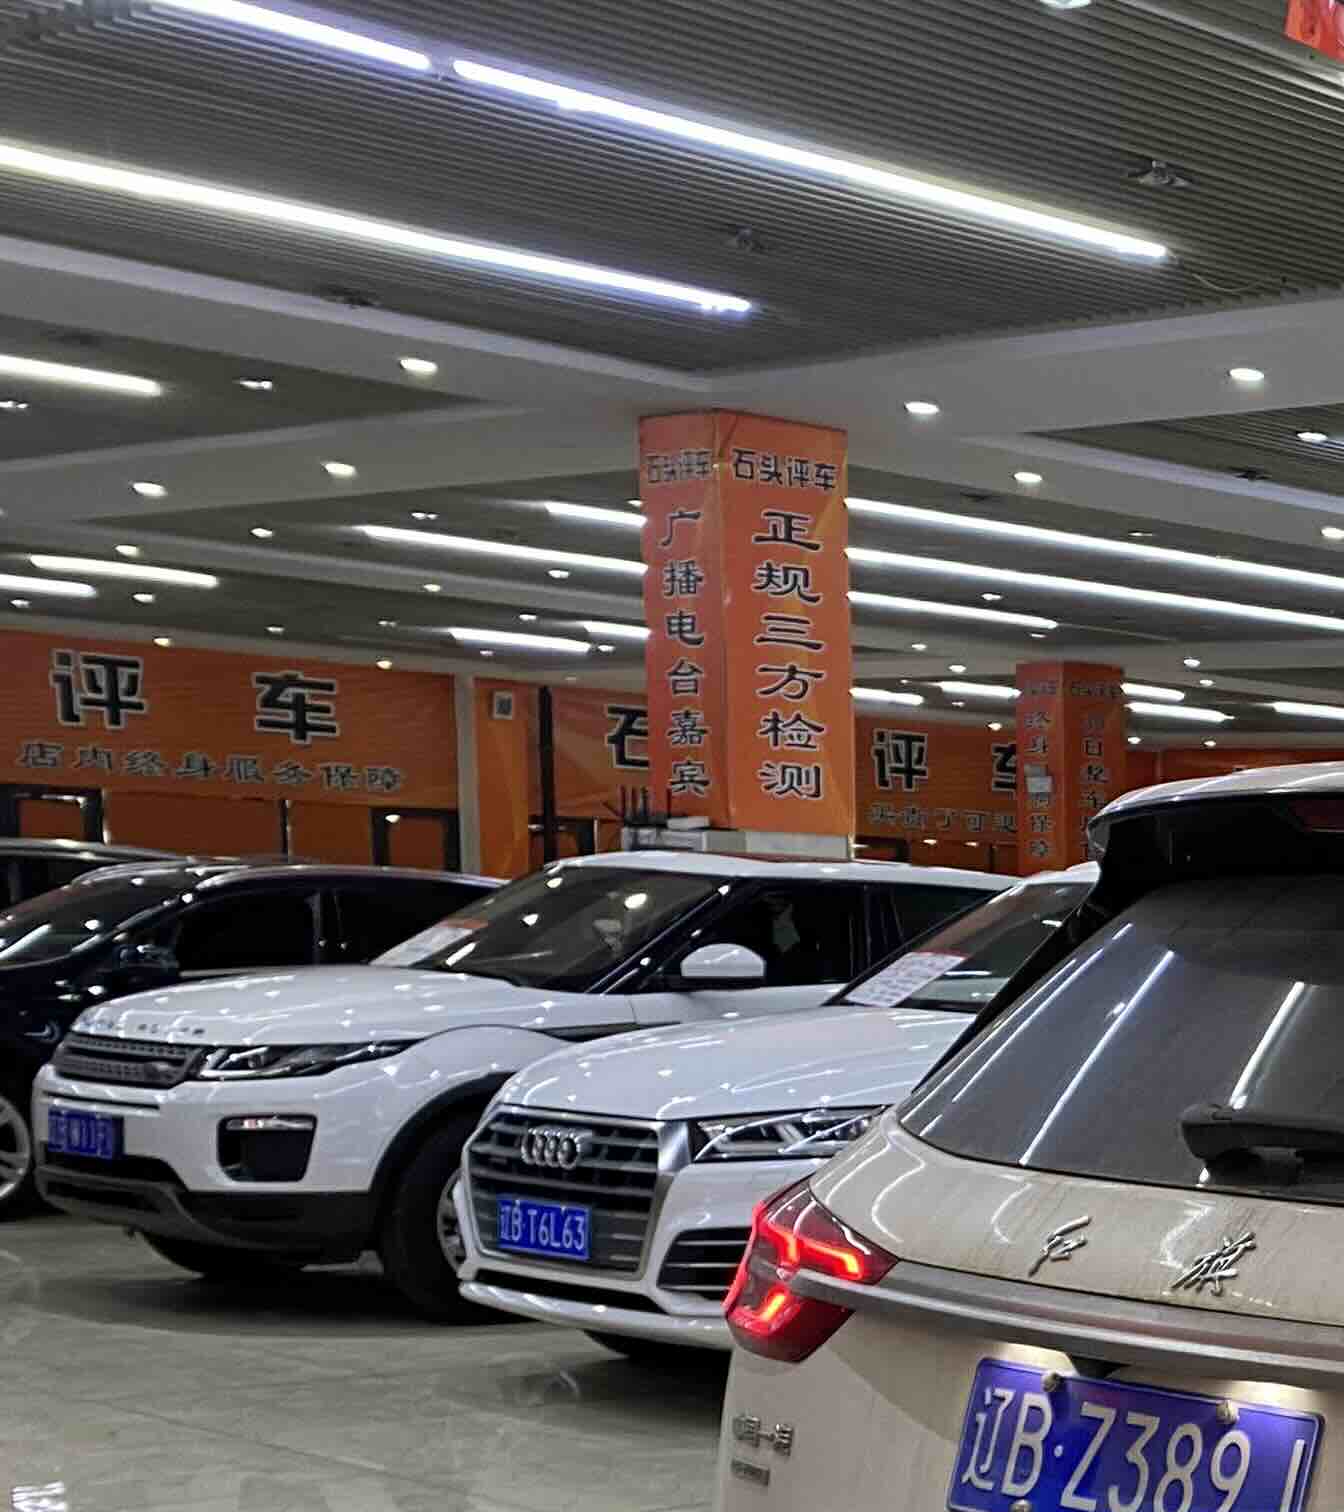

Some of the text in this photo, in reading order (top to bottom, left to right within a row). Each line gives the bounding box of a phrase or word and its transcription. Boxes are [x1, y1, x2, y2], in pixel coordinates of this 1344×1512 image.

[731, 447, 842, 491] 石头评车
[660, 509, 712, 800] 广播电台嘉宾
[751, 510, 826, 801] 正规三方检测
